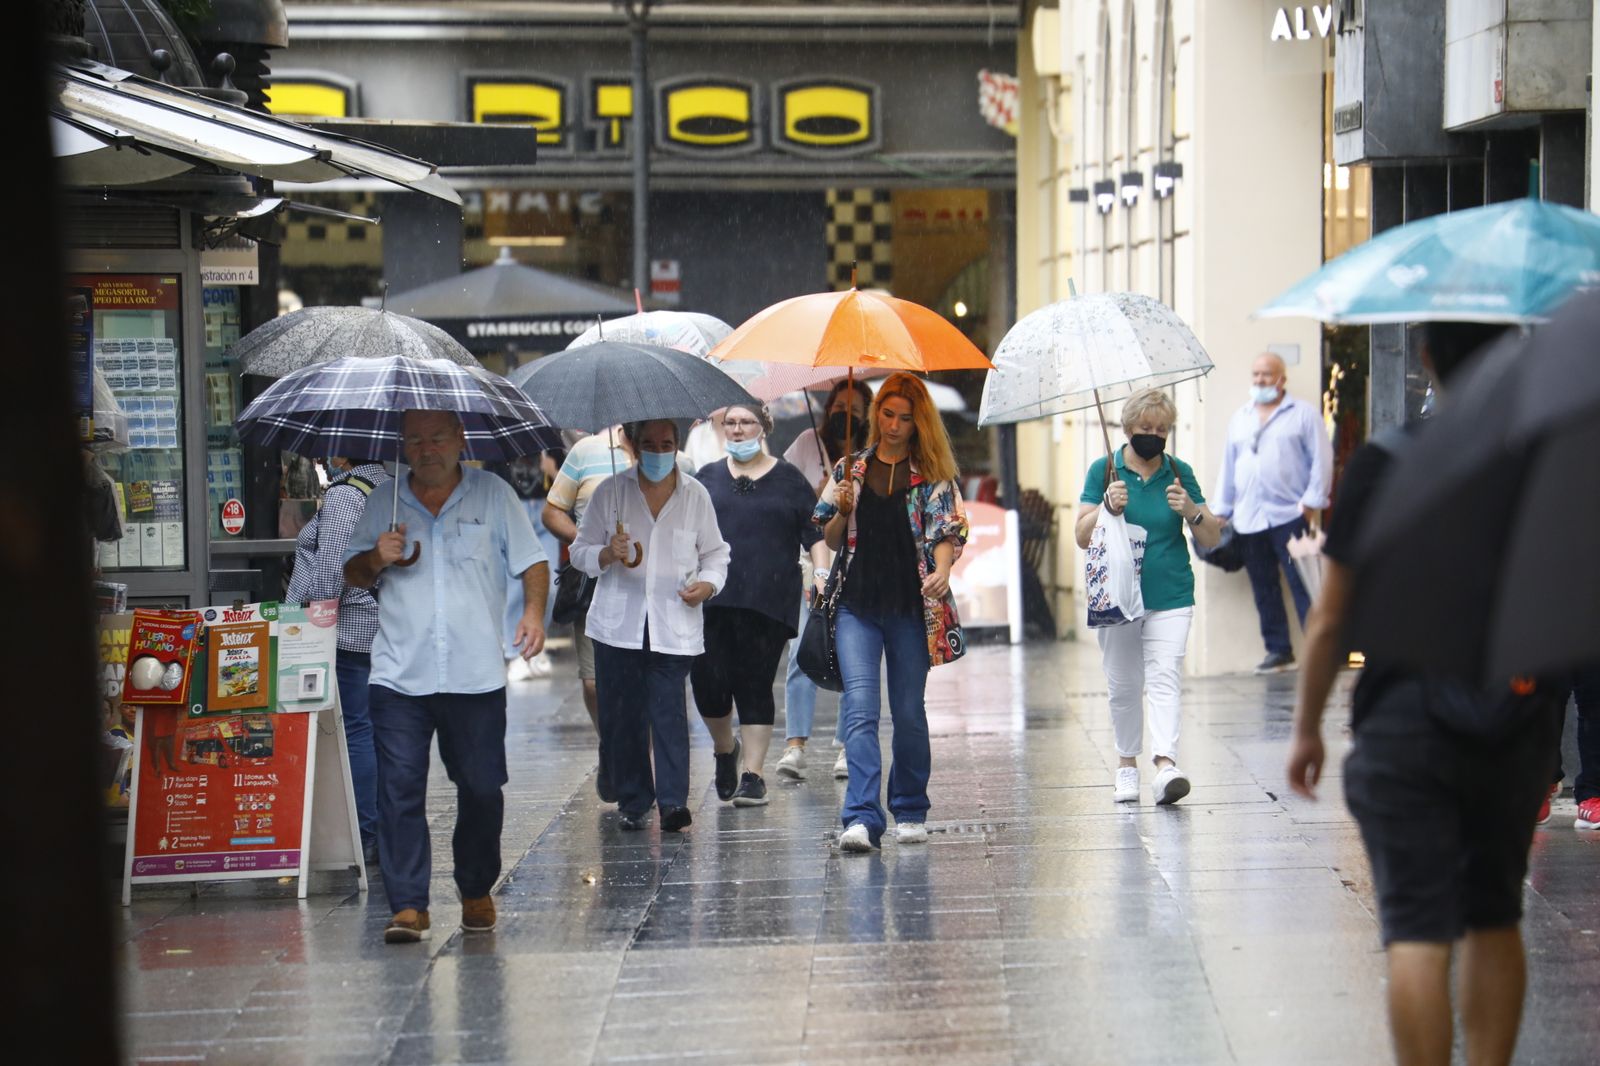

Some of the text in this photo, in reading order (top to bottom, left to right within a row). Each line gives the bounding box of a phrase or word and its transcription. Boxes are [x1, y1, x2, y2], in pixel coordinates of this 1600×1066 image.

[248, 270, 254, 281] 4
[94, 288, 148, 296] MEGASORTEO
[467, 320, 562, 338] STARBUCKS
[227, 503, 240, 515] +18
[166, 794, 174, 807] 9
[171, 836, 180, 849] 2
